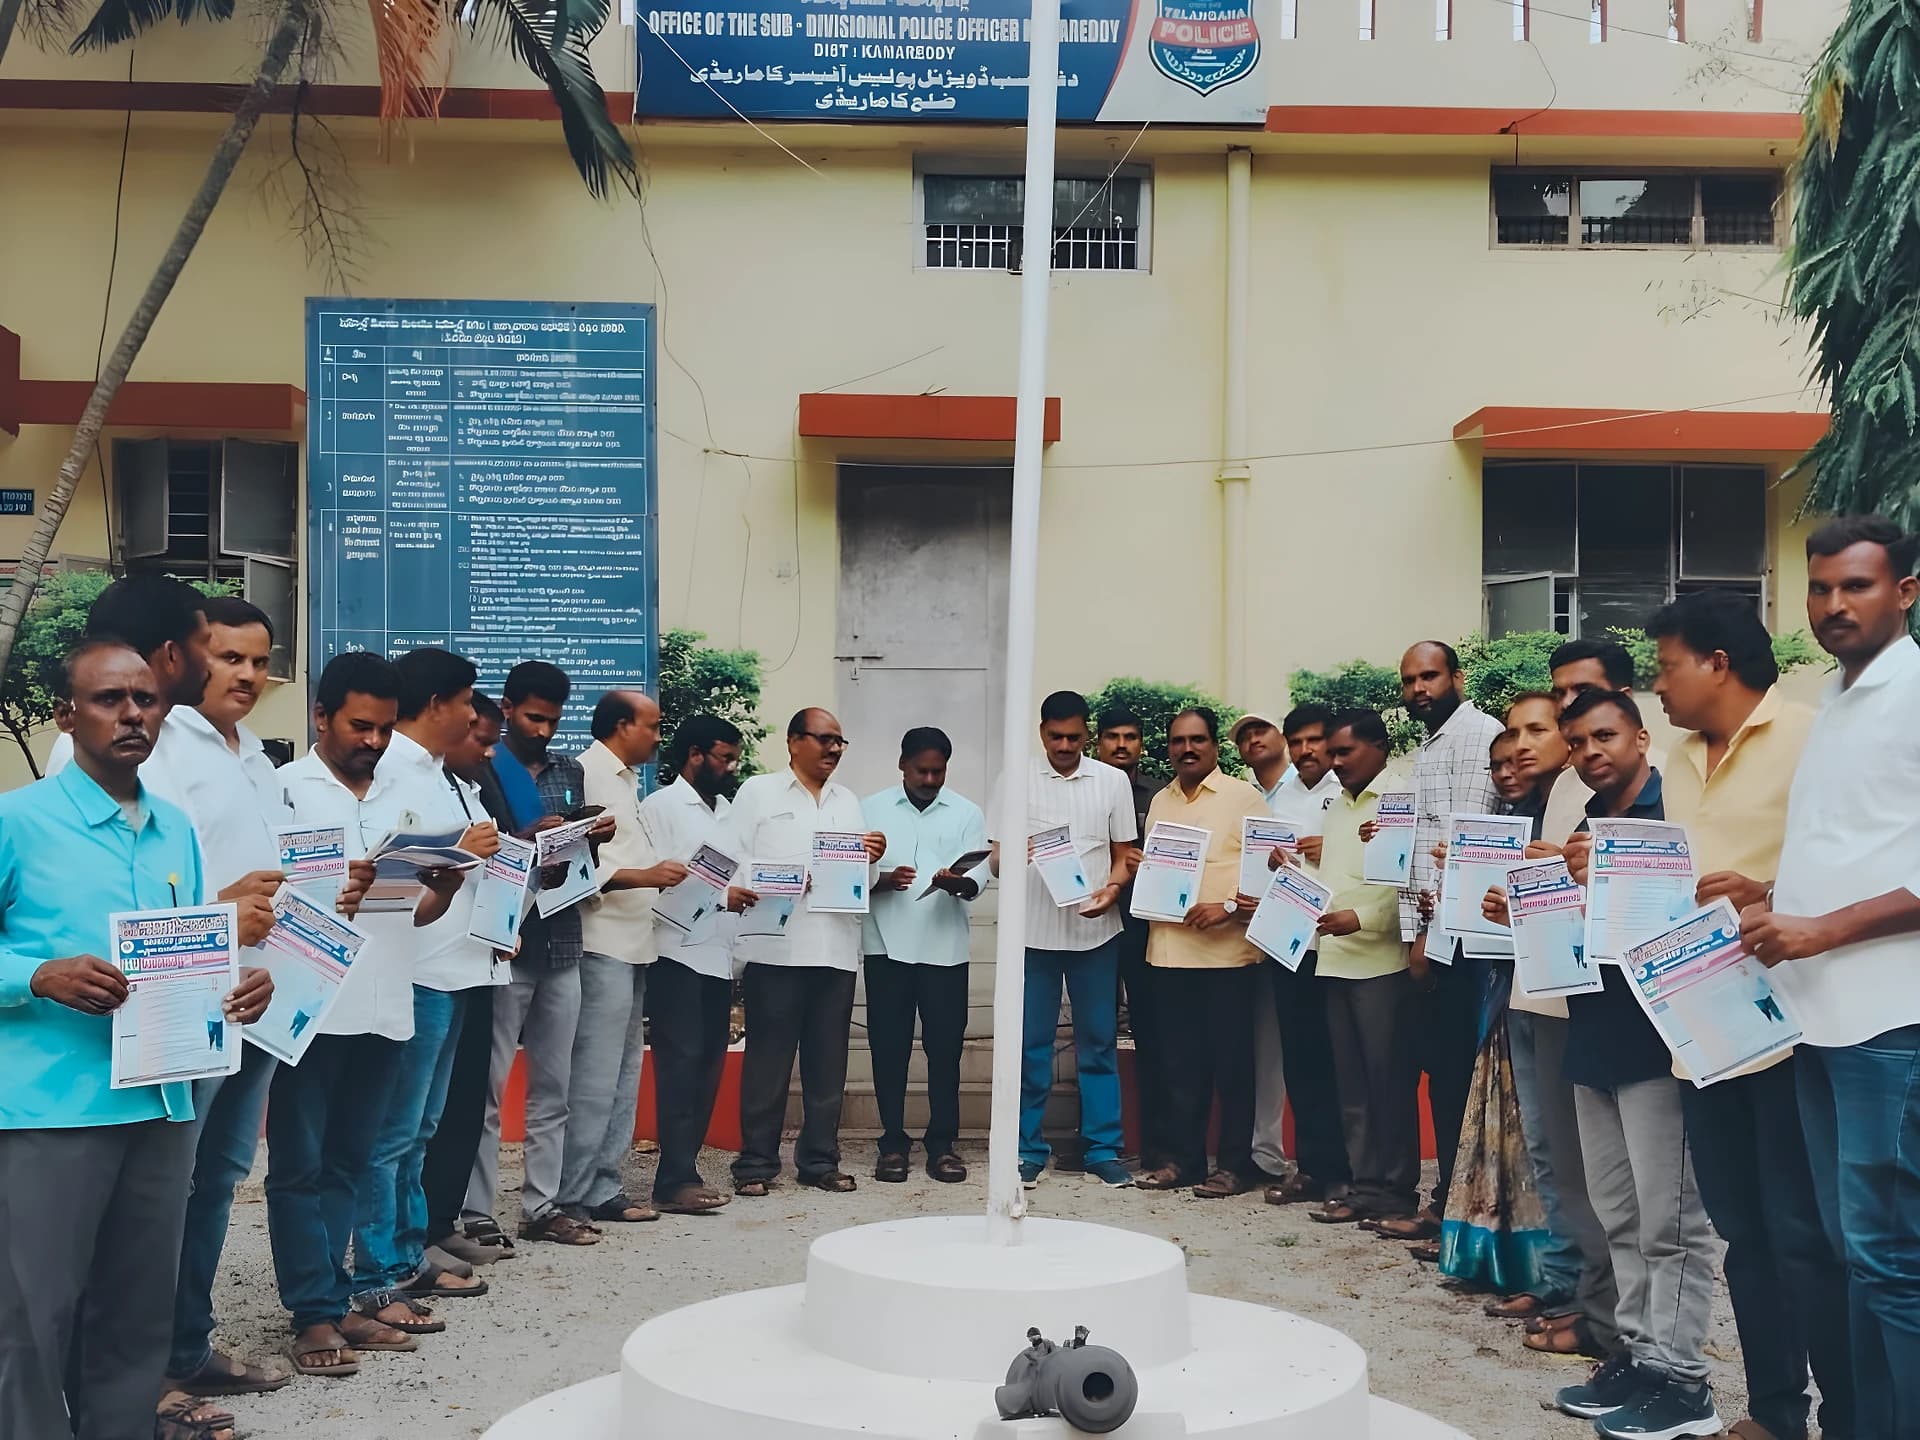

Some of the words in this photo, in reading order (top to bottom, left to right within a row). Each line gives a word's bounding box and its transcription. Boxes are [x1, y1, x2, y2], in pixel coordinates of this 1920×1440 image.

[649, 10, 701, 35] OFFICE
[705, 12, 725, 36] OF
[728, 12, 757, 36] THE
[760, 13, 793, 37] SUB
[806, 14, 896, 39] DIVISIONAL
[900, 17, 953, 41] POLICE
[957, 18, 1019, 42] OFFICER
[1160, 21, 1252, 44] POLICE
